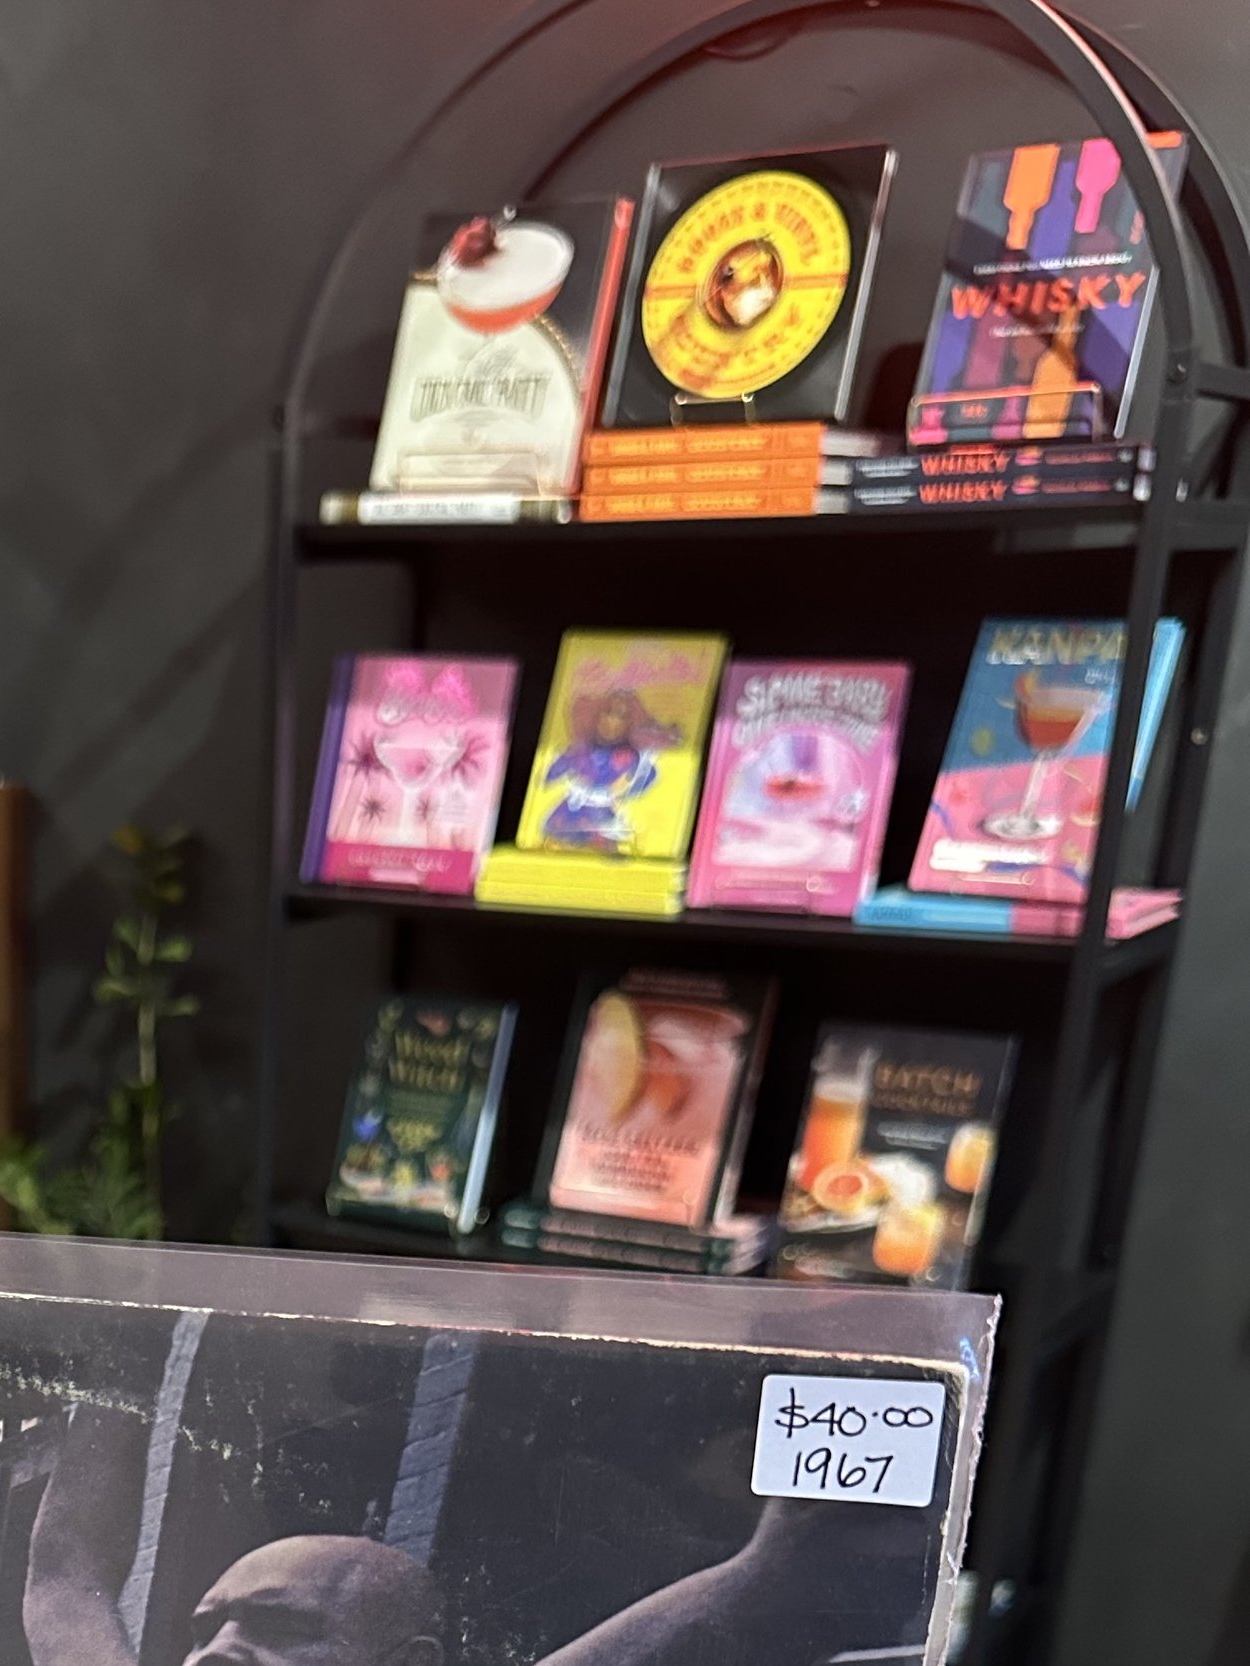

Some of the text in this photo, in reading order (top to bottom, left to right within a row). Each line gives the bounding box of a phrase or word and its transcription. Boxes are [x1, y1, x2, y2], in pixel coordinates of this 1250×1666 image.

[952, 271, 1147, 319] WHISKY
[921, 452, 1010, 475] WHISKY
[919, 481, 1007, 504] WHISKY
[874, 1063, 980, 1098] BATCH
[793, 1447, 894, 1493] 1967
